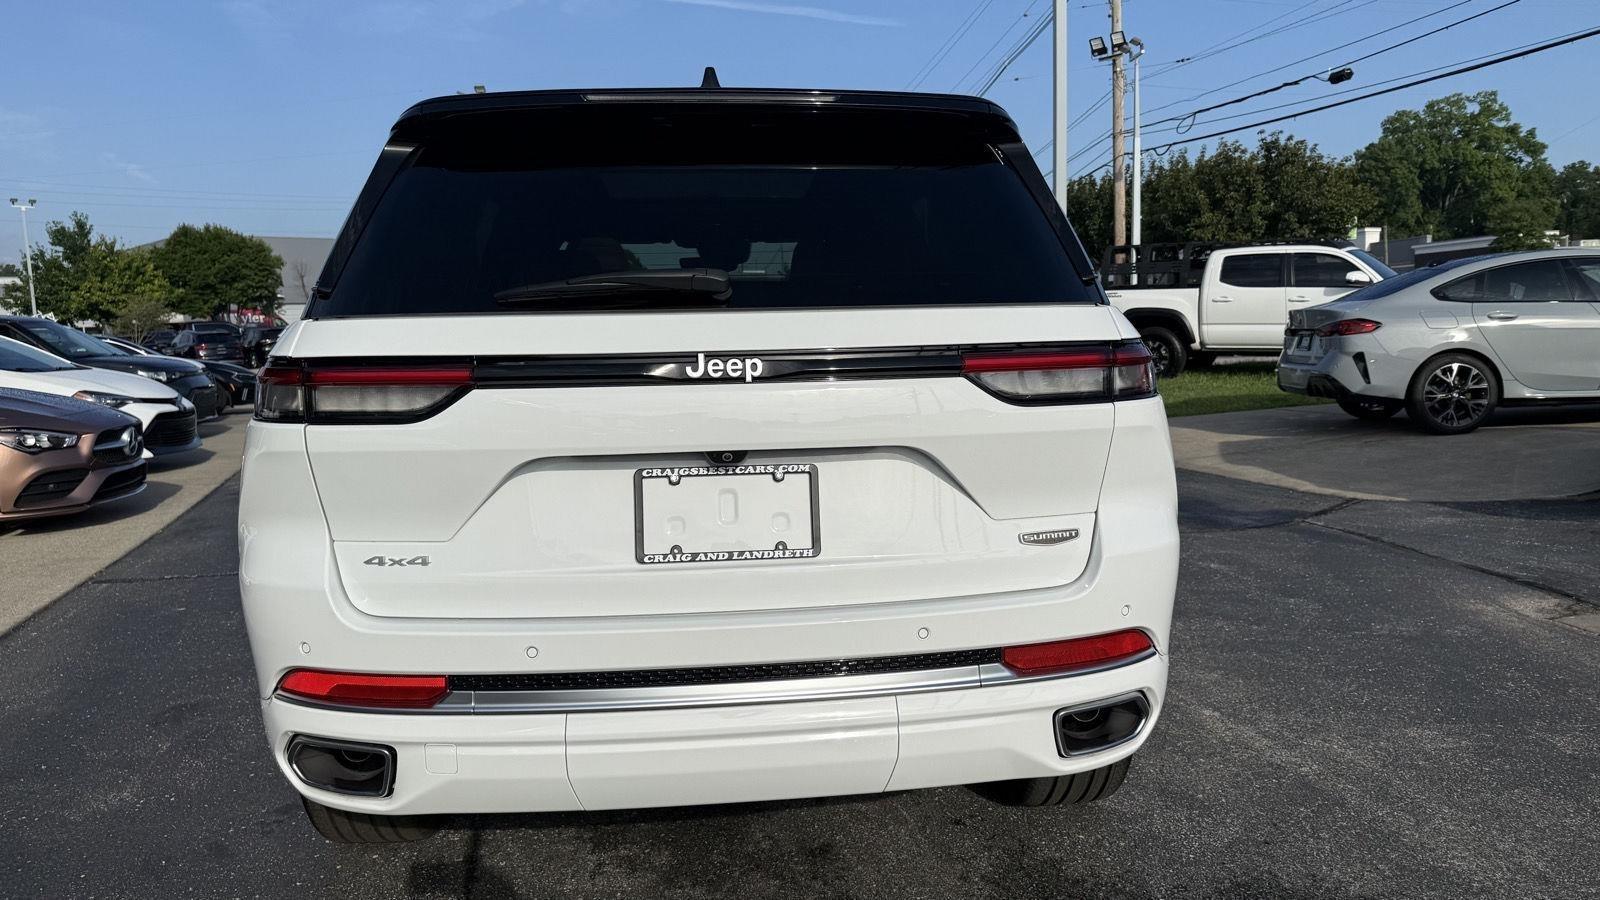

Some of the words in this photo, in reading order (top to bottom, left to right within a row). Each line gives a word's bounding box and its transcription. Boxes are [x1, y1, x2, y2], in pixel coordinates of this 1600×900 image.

[236, 312, 265, 326] yler
[686, 353, 763, 382] Jeep
[642, 465, 810, 477] CRAIGSBESTCARS.COM
[1023, 530, 1077, 541] SUMMIT
[363, 556, 431, 566] 4x4
[643, 553, 692, 563] CRAIG
[695, 552, 729, 561] AND
[732, 549, 814, 560] LANDRETH
